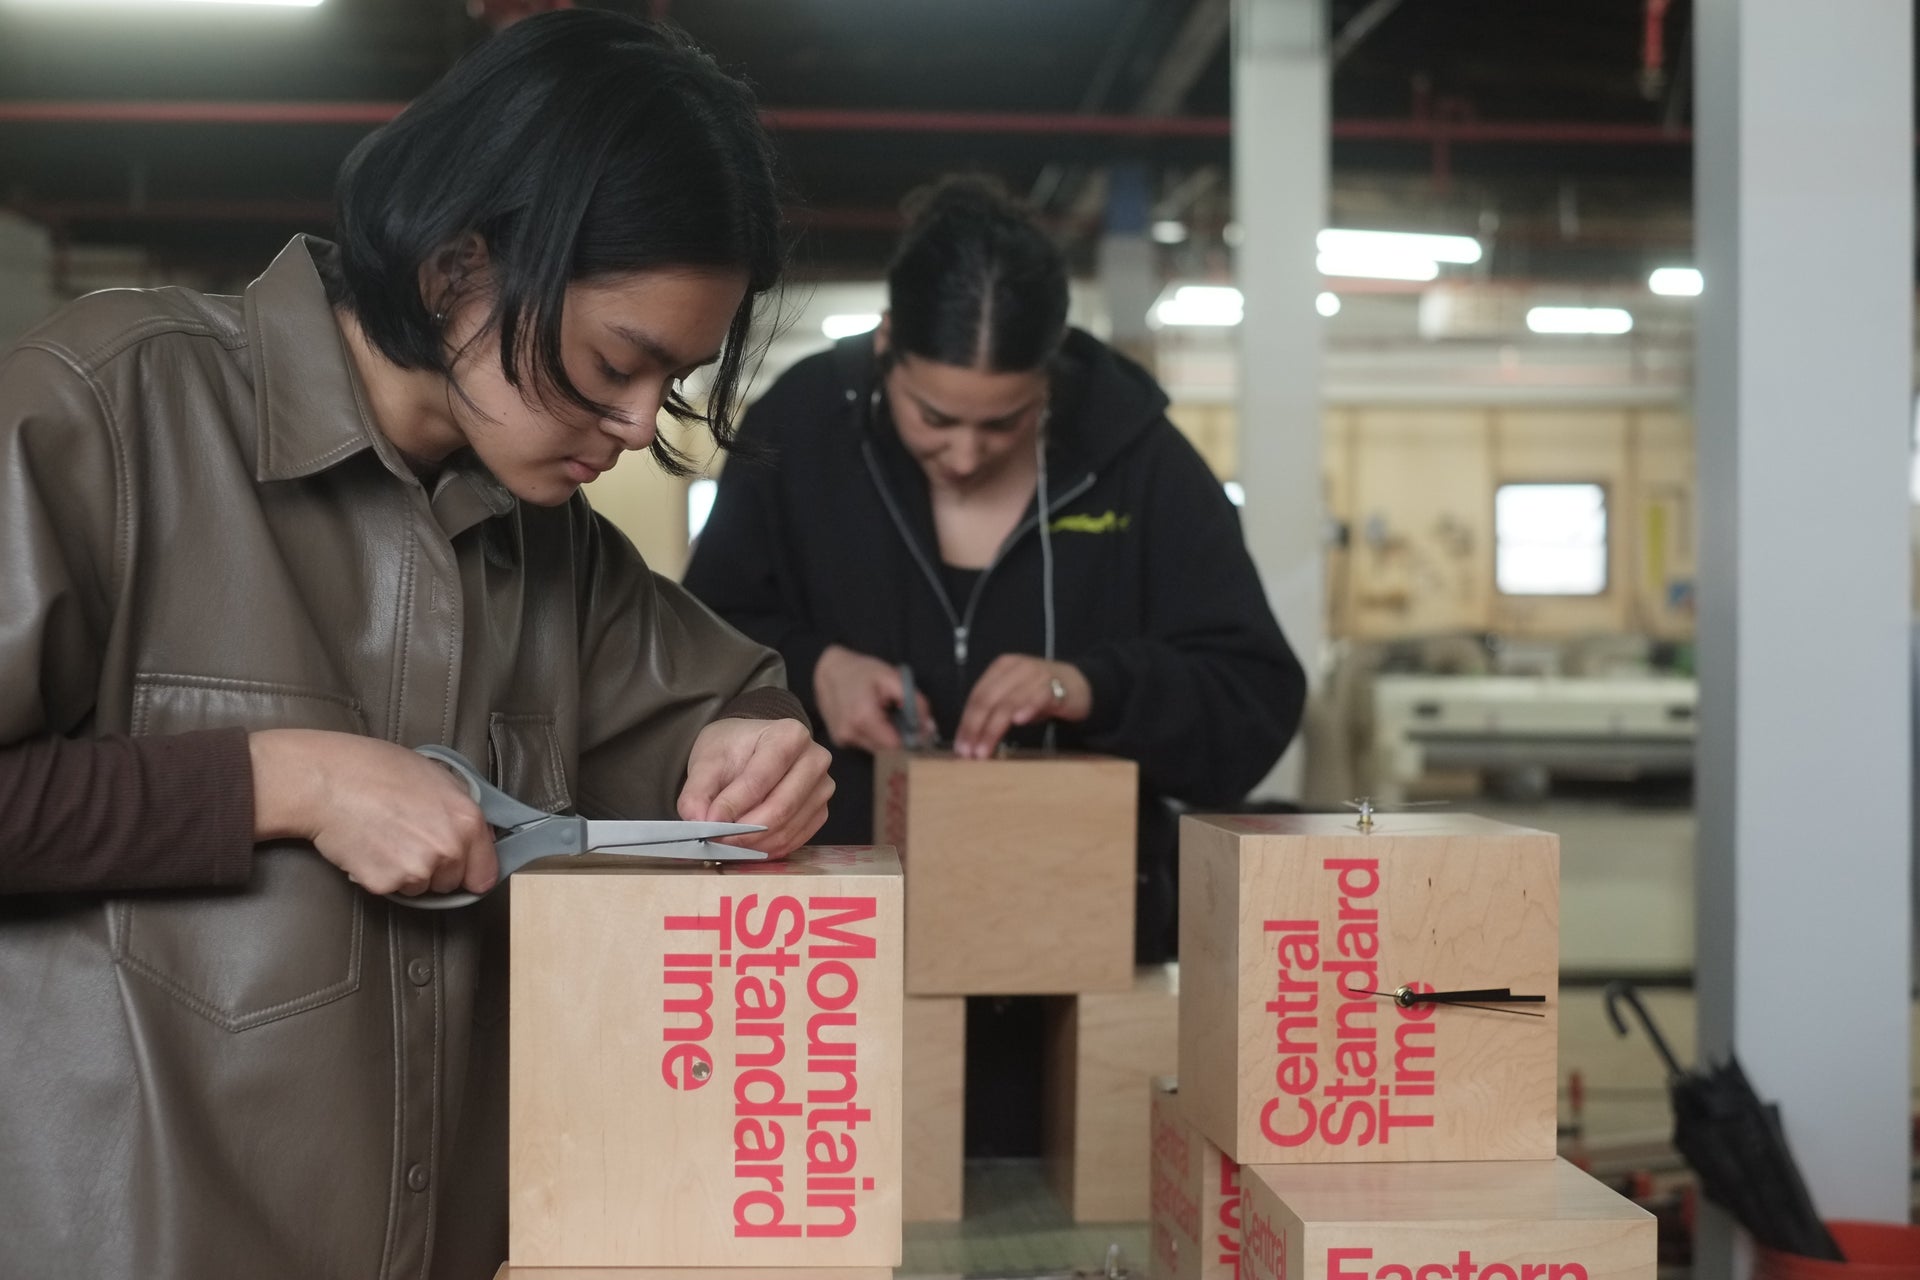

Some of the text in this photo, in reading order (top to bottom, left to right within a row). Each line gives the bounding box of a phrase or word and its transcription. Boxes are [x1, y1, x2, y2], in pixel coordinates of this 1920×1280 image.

[661, 895, 733, 1091] Time
[733, 893, 806, 1238] Standard
[805, 896, 877, 1238] Mountain
[1260, 919, 1320, 1148] Central
[1319, 858, 1380, 1147] Standard
[1379, 981, 1436, 1145] Time
